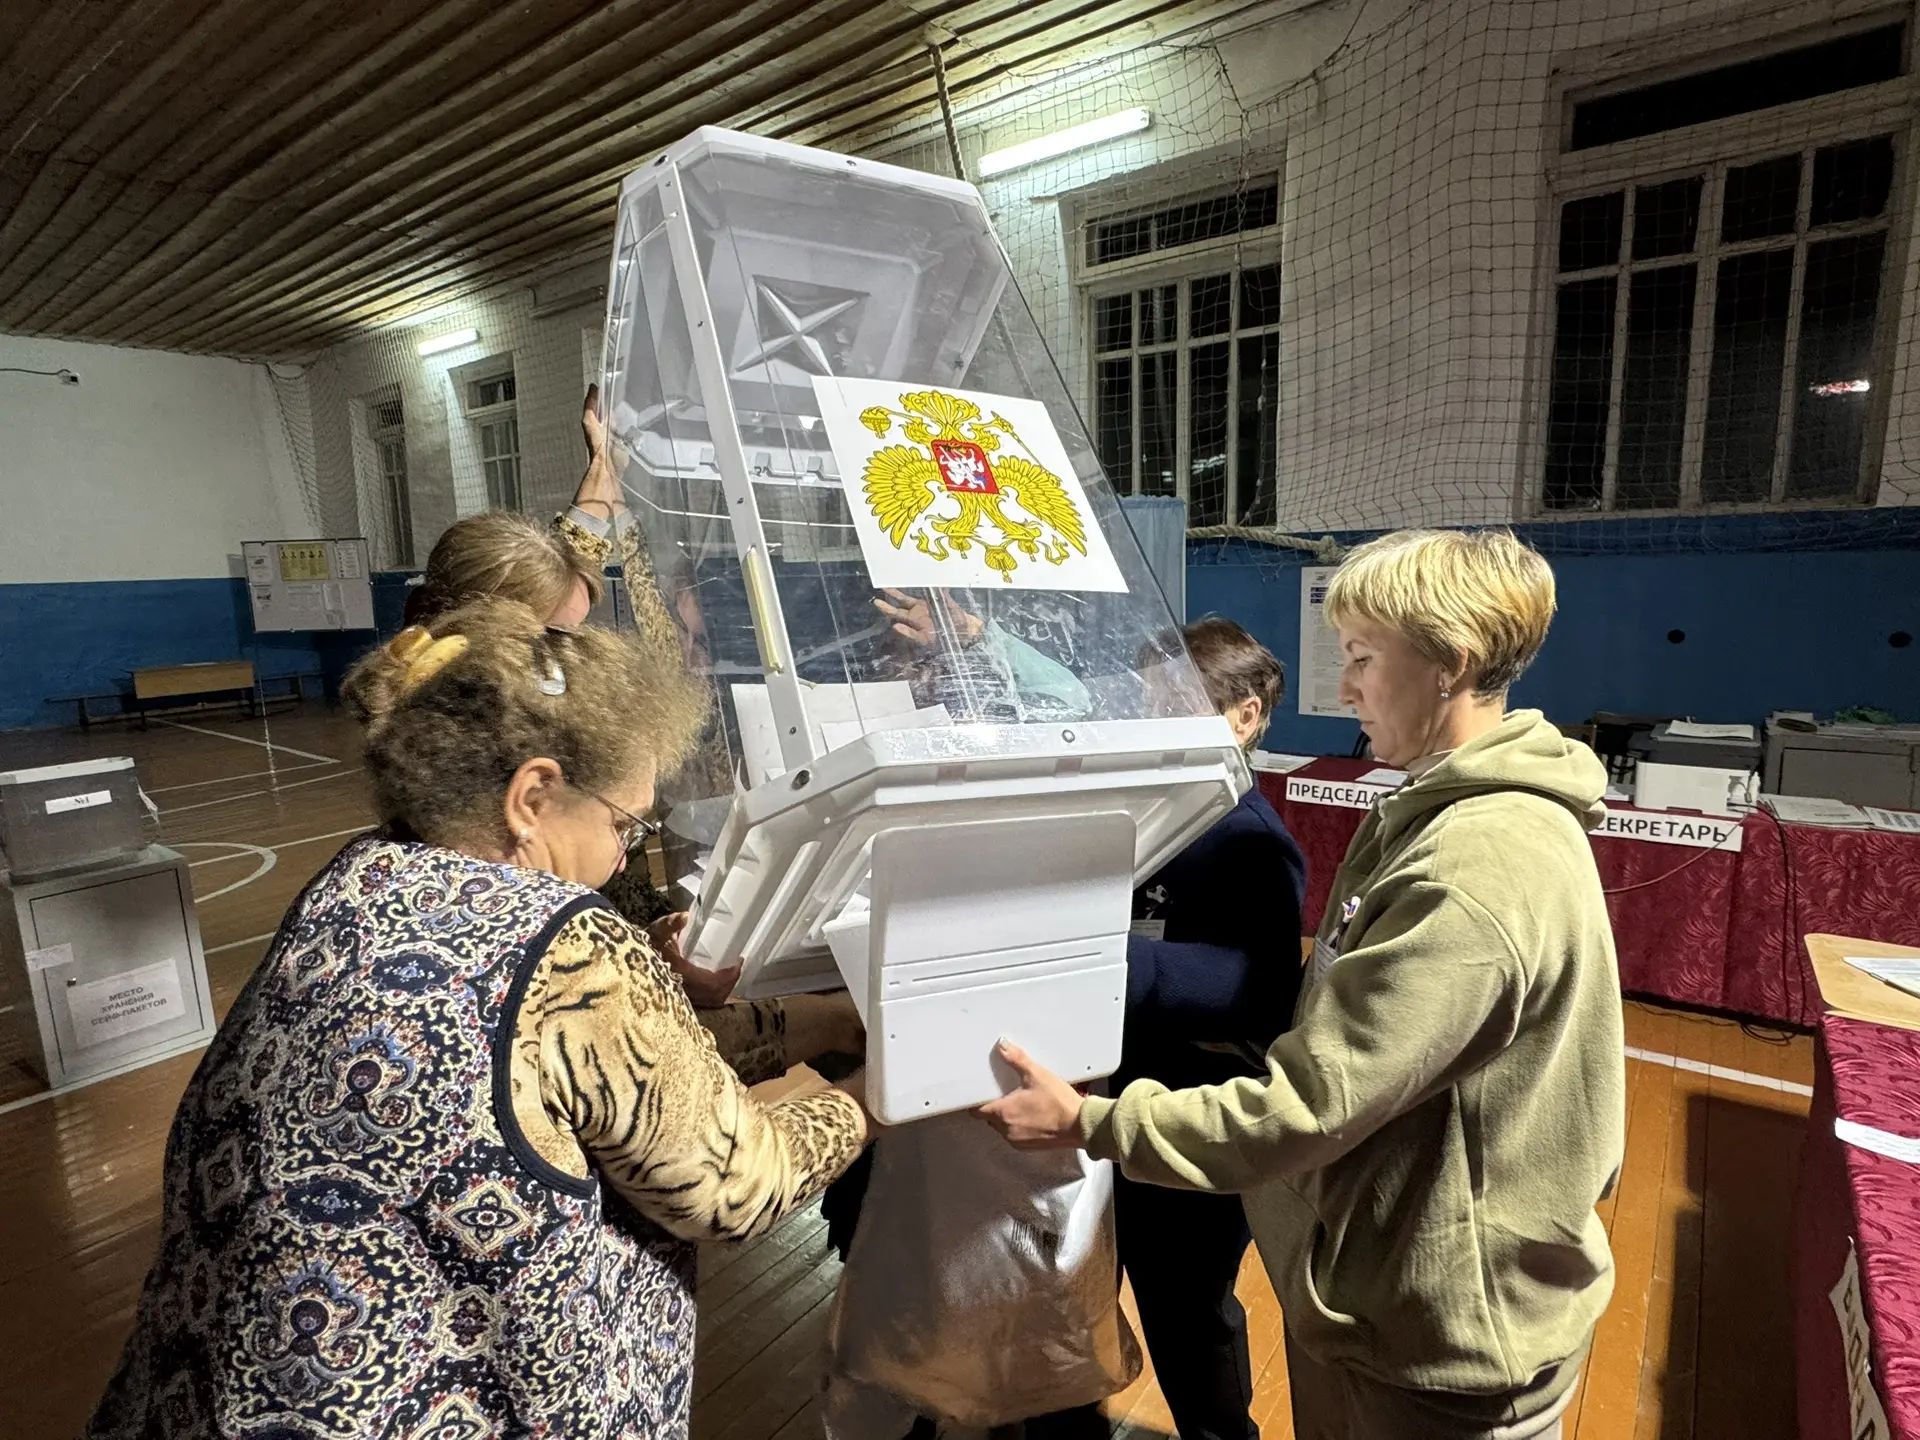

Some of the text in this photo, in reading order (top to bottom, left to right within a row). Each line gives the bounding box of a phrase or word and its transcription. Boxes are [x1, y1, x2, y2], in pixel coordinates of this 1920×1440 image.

[1595, 817, 1727, 843] ЕКРЕТАРЬ
[101, 992, 154, 1013] ХРАНЕНИЯ
[109, 986, 144, 1001] МЕСТО
